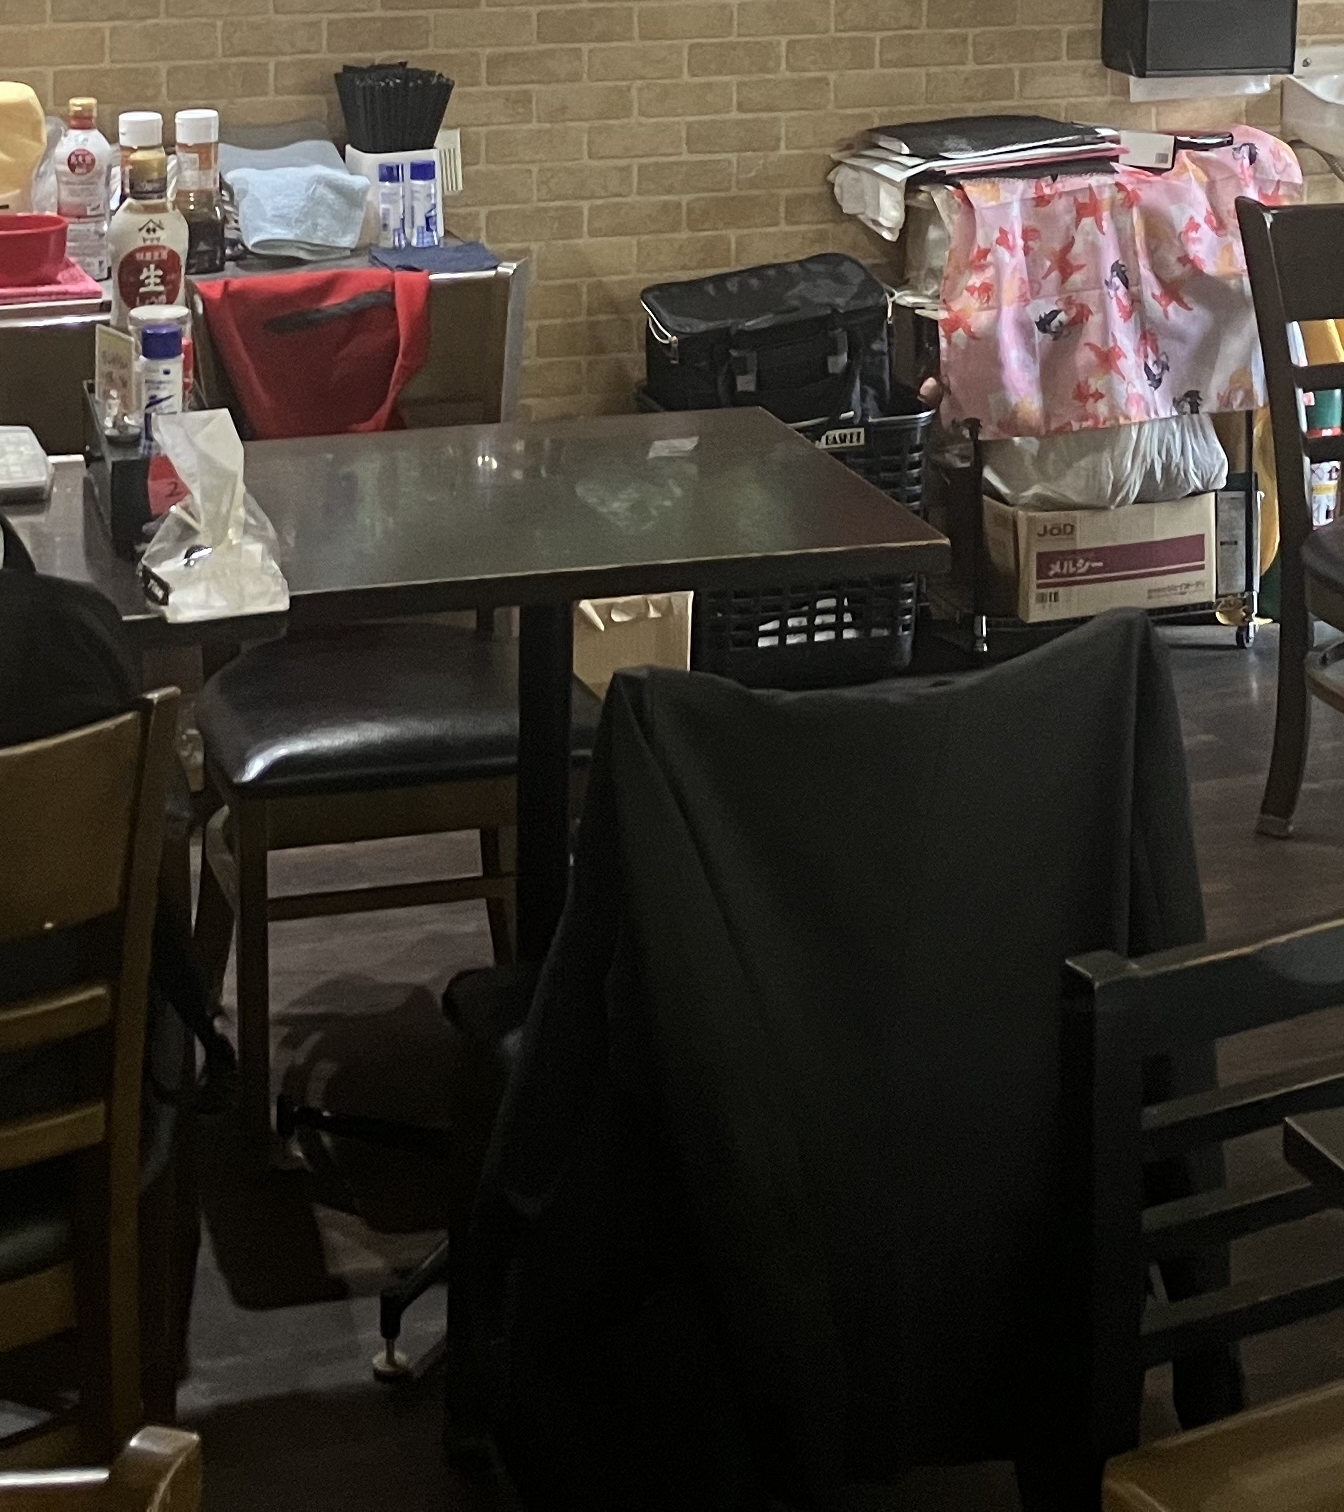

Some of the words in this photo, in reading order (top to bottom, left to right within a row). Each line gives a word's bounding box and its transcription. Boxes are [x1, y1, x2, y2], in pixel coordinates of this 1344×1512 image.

[138, 264, 165, 292] 生
[1048, 557, 1104, 576] メルシー
